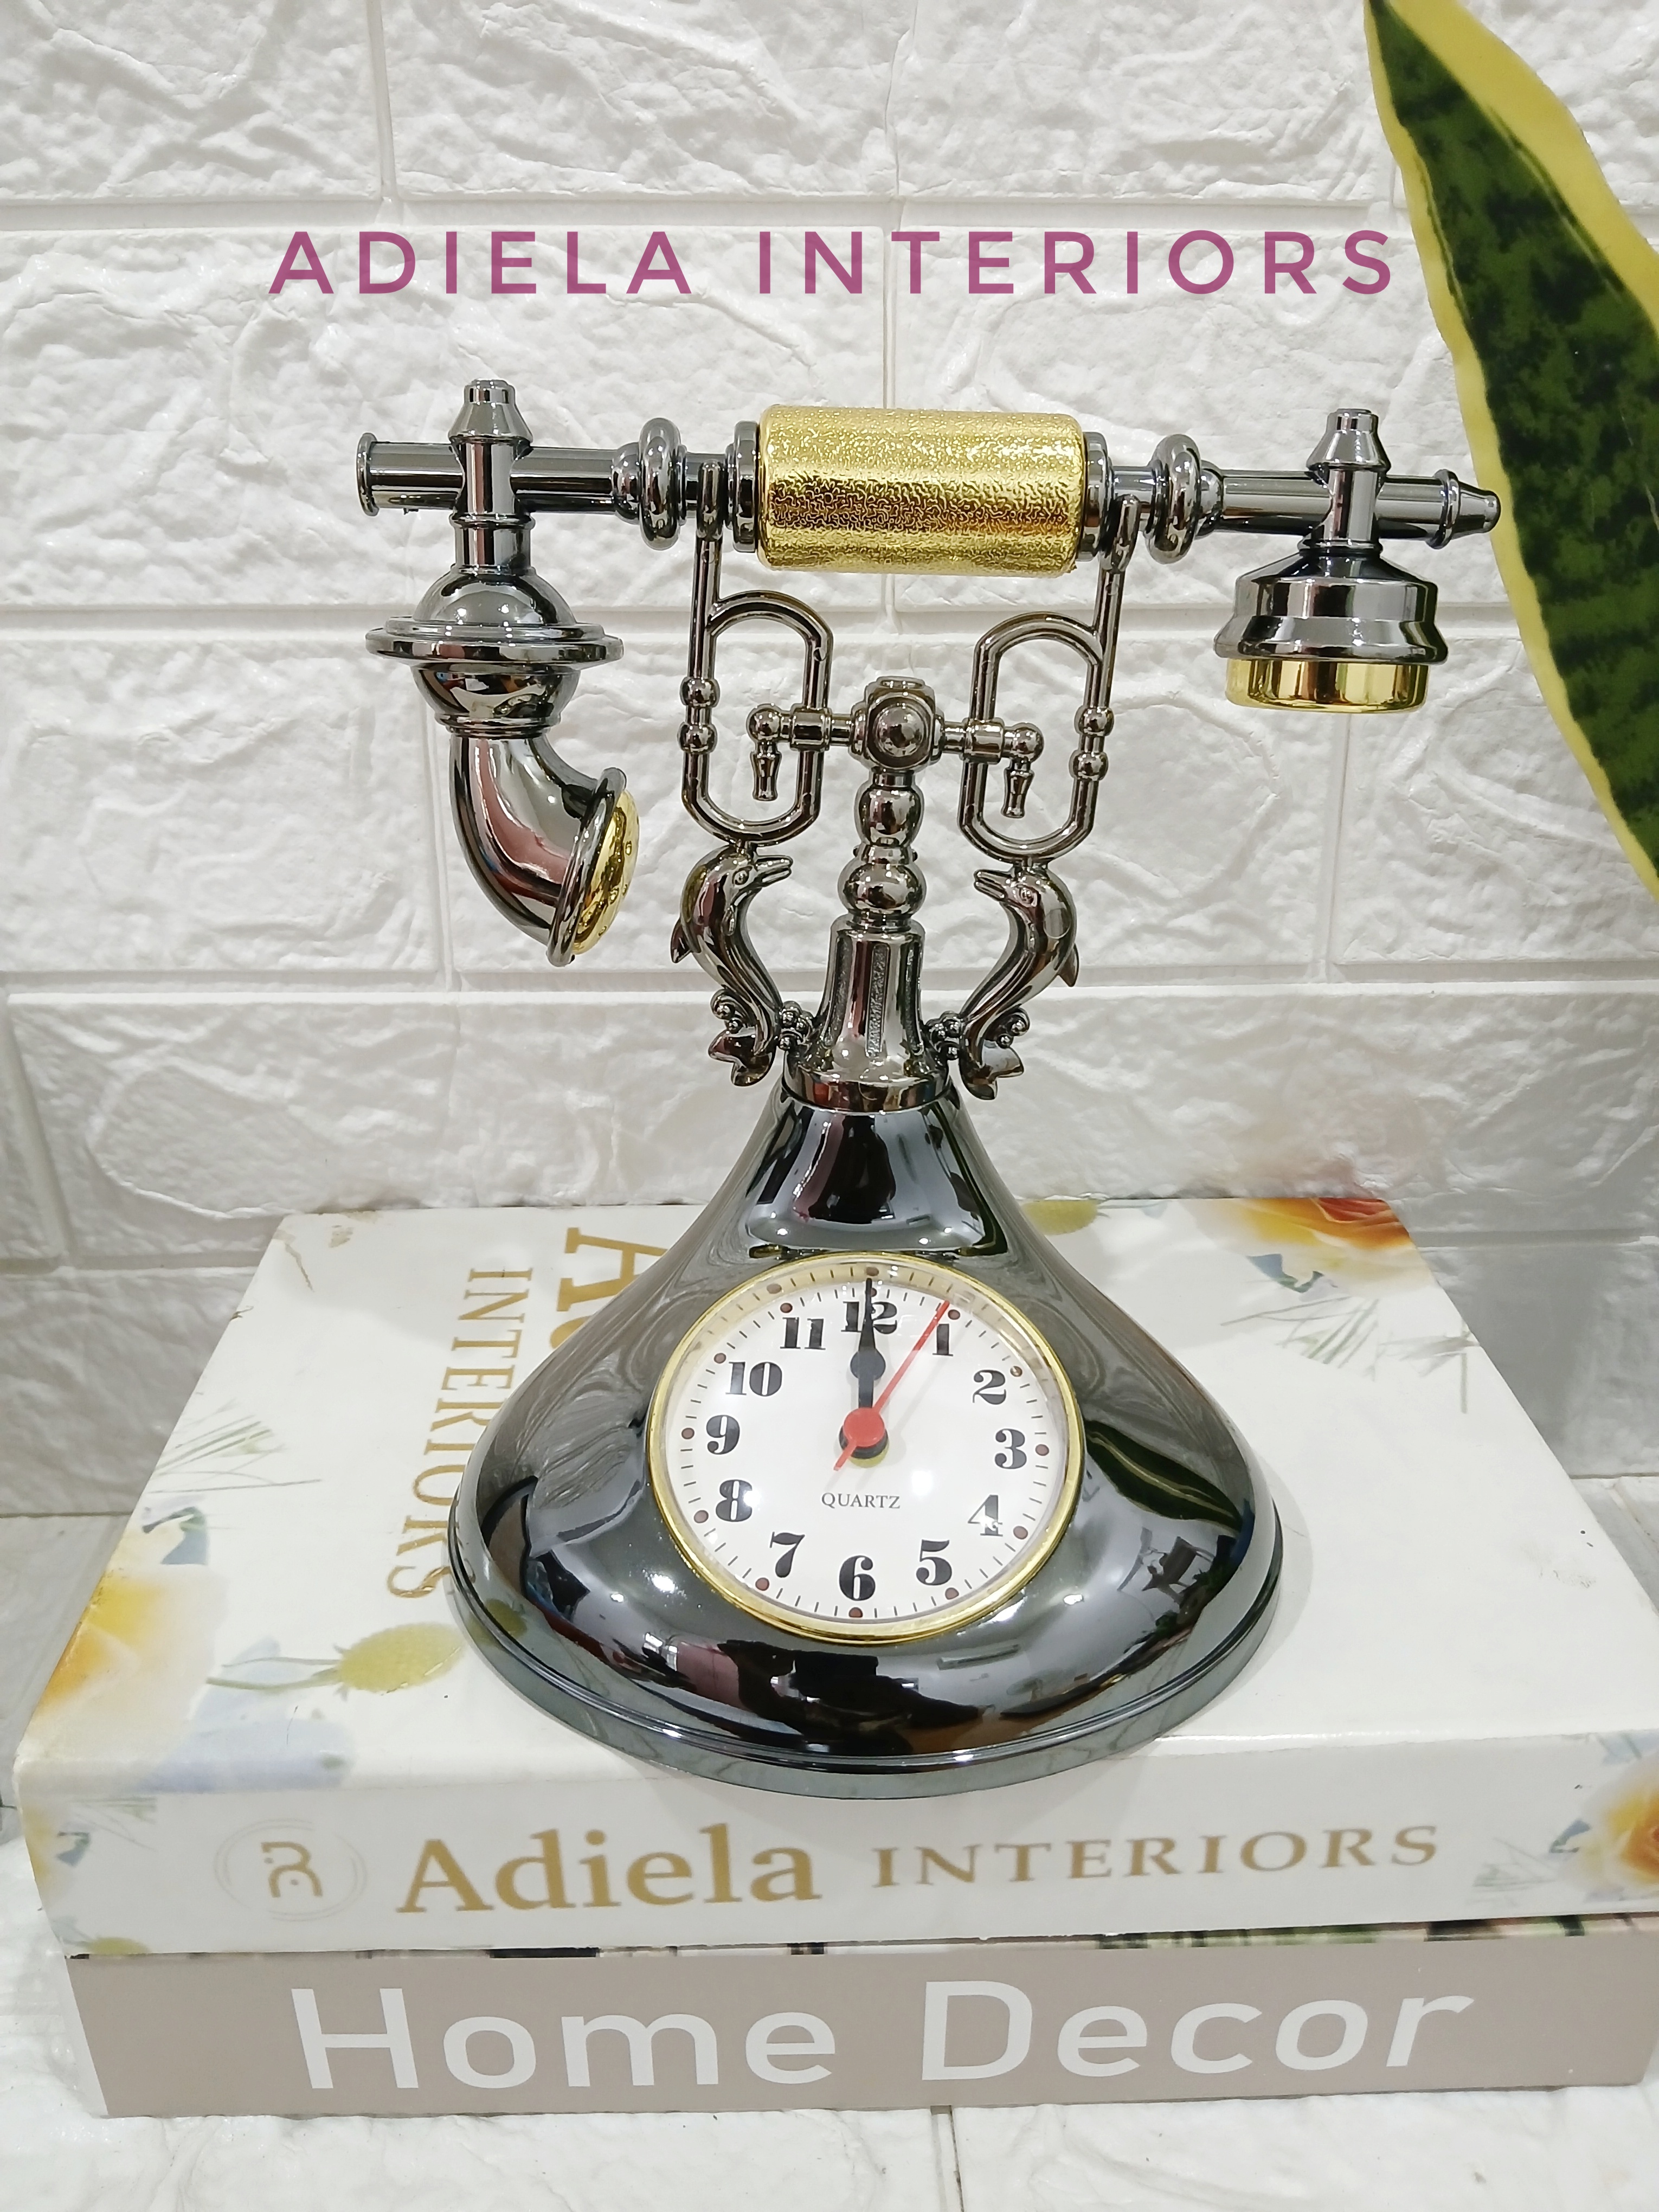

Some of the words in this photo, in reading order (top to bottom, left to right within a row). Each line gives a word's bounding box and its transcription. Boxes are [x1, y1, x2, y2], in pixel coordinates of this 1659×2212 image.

[780, 1316, 826, 1351] 11
[841, 1301, 898, 1334] 12
[932, 1323, 954, 1356] 1
[725, 1361, 783, 1397] 10
[972, 1369, 1007, 1405] 2
[705, 1414, 741, 1455] 9
[994, 1428, 1027, 1470] 3
[715, 1478, 754, 1523] 8
[821, 1492, 901, 1510] QUARTZ
[967, 1494, 1004, 1537] 4
[769, 1532, 806, 1578] 7
[916, 1539, 953, 1586] 5
[838, 1554, 876, 1602] 6
[396, 1823, 822, 1914] Adiela
[871, 1825, 1438, 1889] INTERIORS
[291, 1988, 837, 2089] Home
[921, 1980, 1475, 2081] Decor
